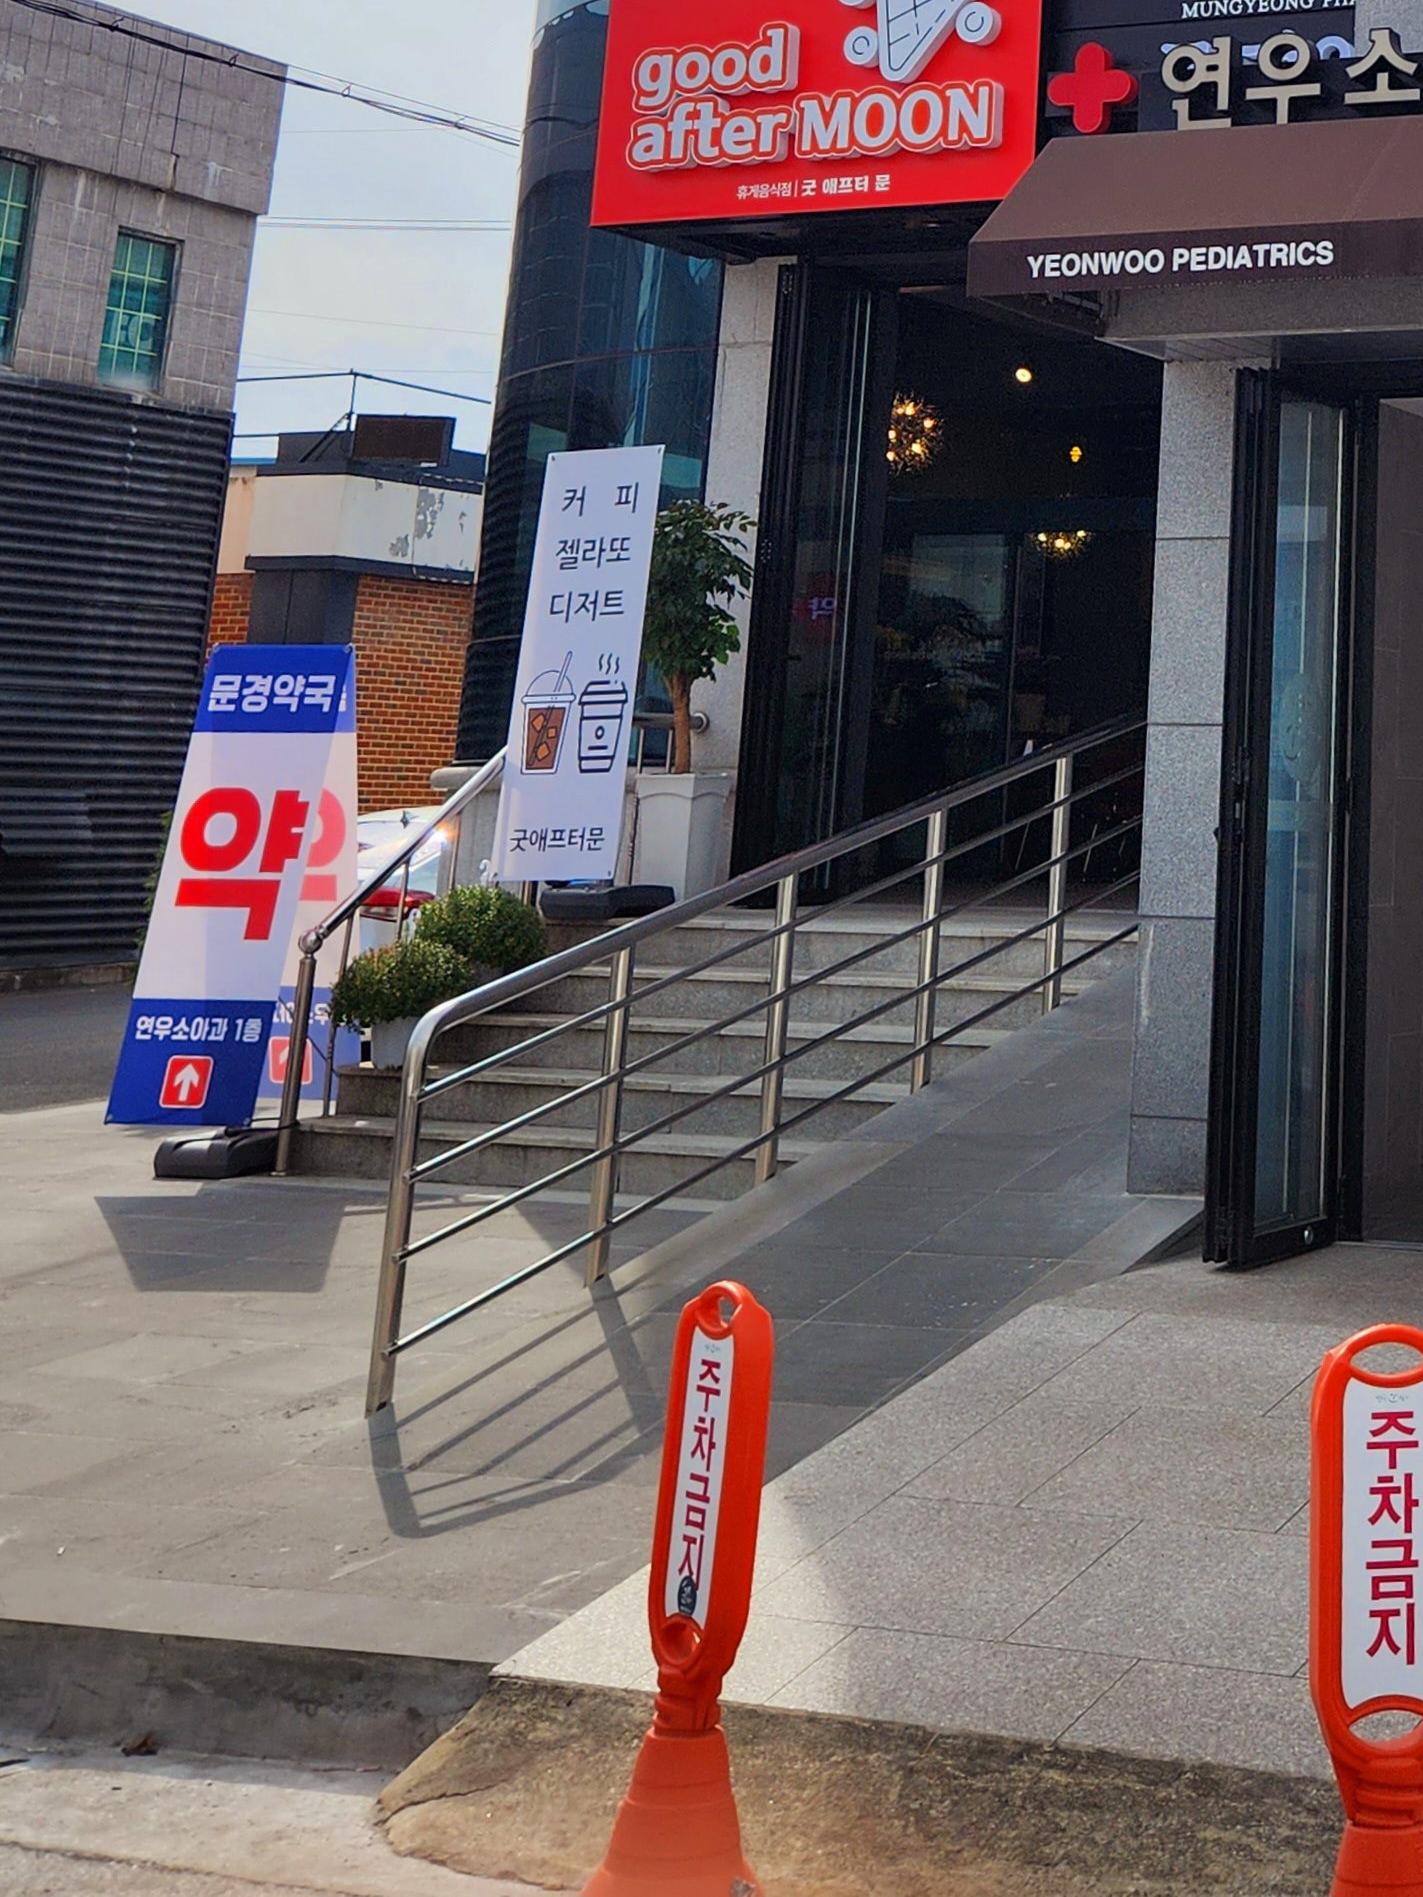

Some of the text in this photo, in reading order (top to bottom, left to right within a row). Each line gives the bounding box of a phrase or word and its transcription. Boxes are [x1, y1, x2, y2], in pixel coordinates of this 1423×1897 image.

[634, 24, 790, 110] good
[630, 80, 996, 166] after MOON
[736, 173, 891, 200] 휴게음식점 굿 애프터 문
[1027, 240, 1335, 279] YEONWOO PEDIATRICS
[555, 535, 632, 571] 젤라또
[549, 589, 625, 624] 디저트
[207, 674, 337, 713] 문경약국
[509, 827, 605, 853] 굿애프터문
[174, 786, 310, 941] 약
[135, 1015, 263, 1043] 연우소아과 1층
[678, 1358, 722, 1592] 주차금지
[1365, 1410, 1420, 1666] 주차금지
